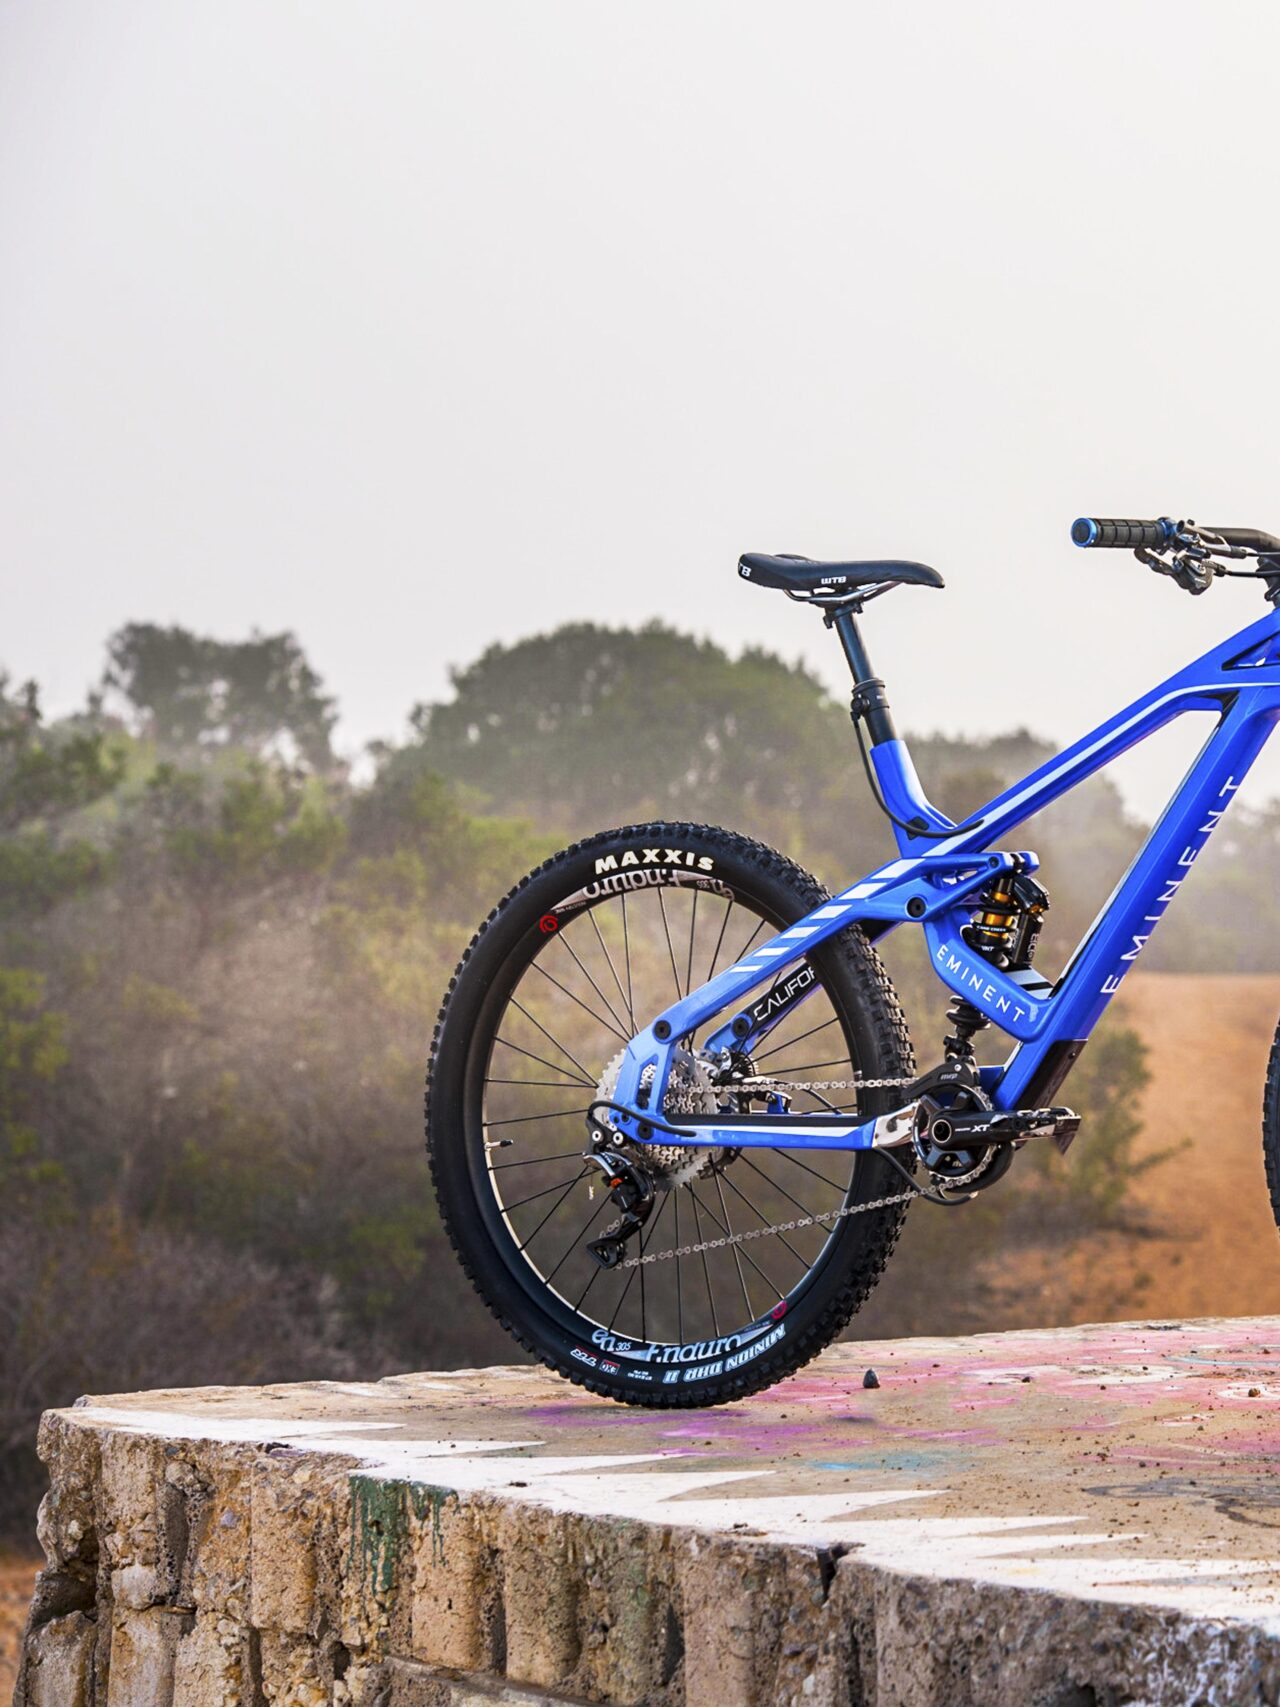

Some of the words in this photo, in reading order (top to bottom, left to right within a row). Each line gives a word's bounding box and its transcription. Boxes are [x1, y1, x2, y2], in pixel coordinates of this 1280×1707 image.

[821, 576, 847, 584] WTB
[595, 849, 715, 875] MAXXIS
[1100, 776, 1240, 993] EMINENT
[936, 944, 1026, 1022] EMINENT
[971, 1124, 990, 1133] XT
[615, 1342, 633, 1351] 305
[725, 1323, 786, 1372] MINION
